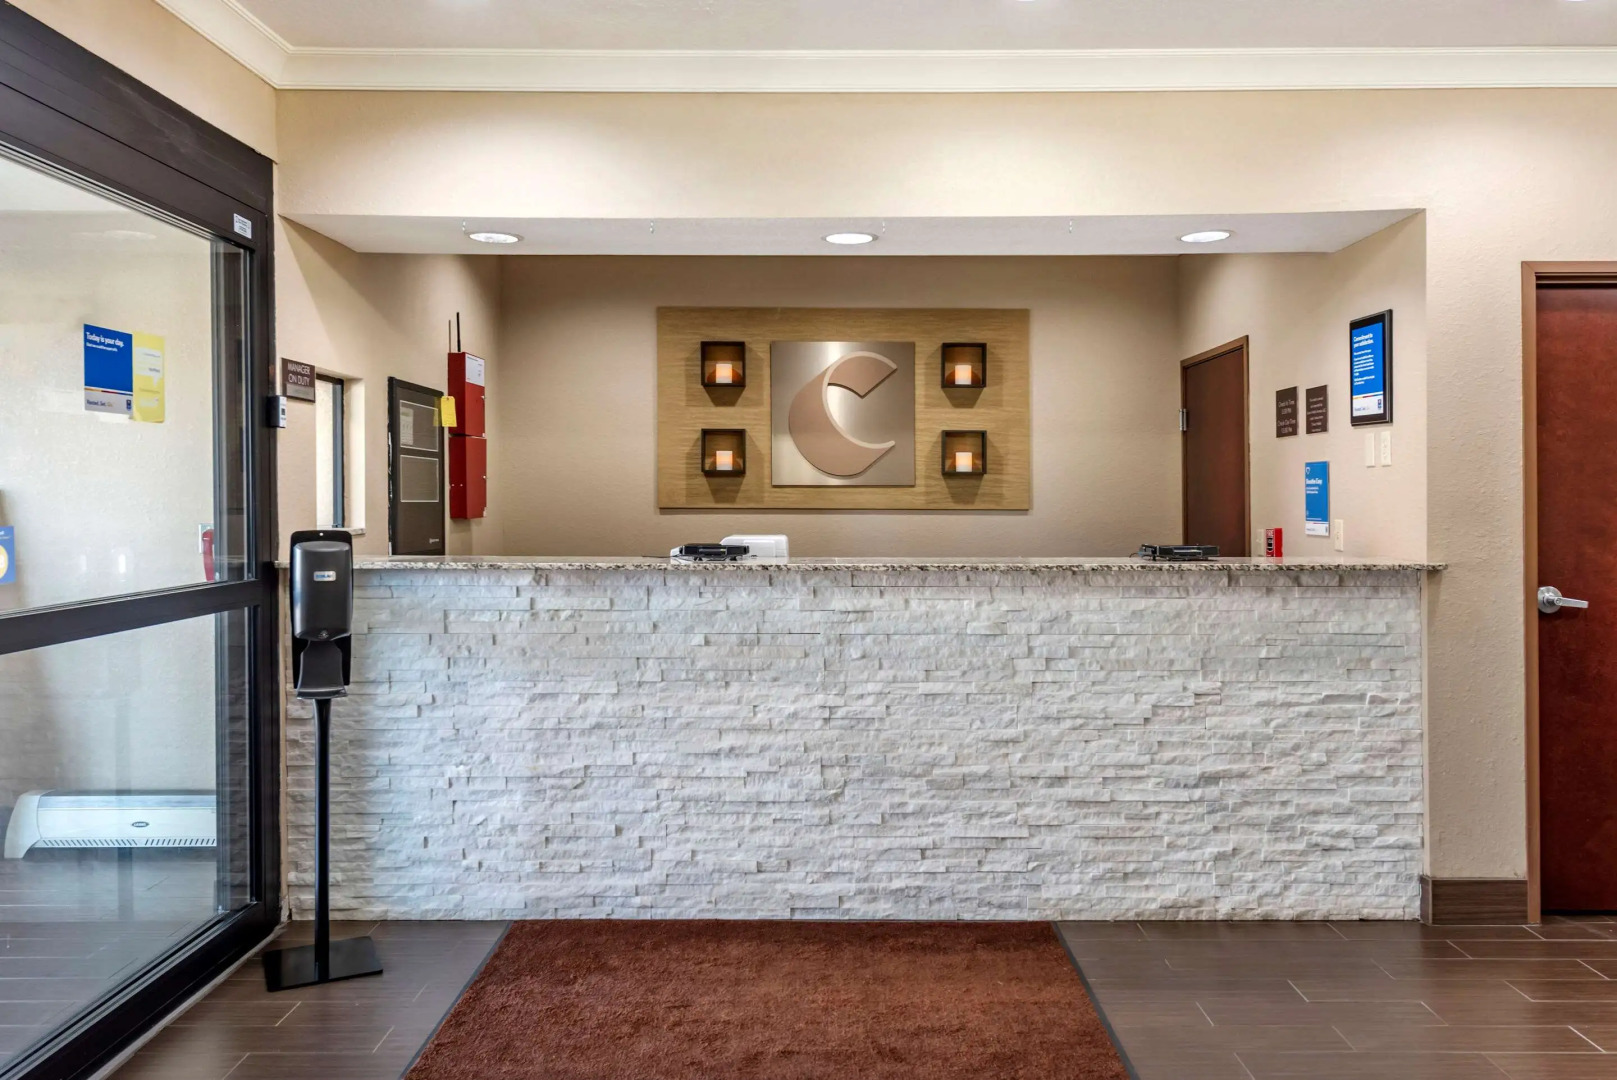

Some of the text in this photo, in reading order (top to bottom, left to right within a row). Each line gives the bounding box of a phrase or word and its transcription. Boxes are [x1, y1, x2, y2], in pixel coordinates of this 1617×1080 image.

[86, 332, 100, 343] Today
[288, 361, 310, 375] MANAGER
[288, 373, 310, 386] ON DUTY
